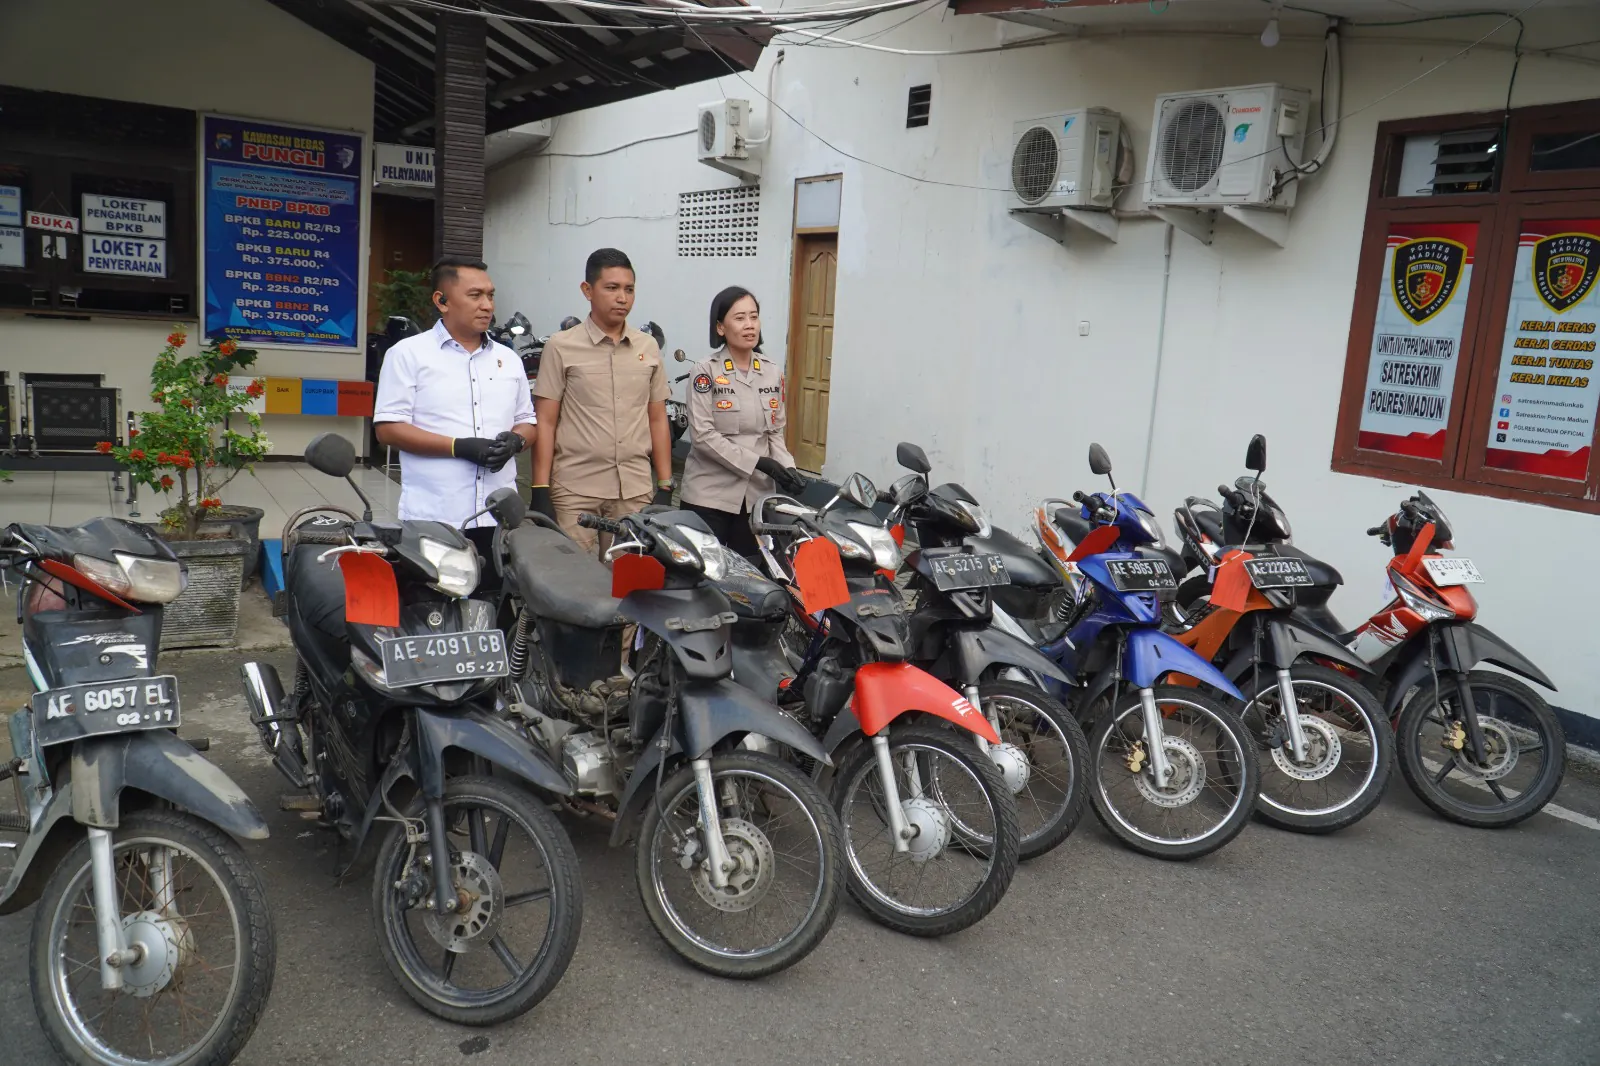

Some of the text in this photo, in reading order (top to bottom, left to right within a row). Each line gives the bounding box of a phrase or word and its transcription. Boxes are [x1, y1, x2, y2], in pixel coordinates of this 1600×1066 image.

[243, 130, 325, 150] KAWASAN BEBAS
[243, 143, 325, 168] PUNGLI
[382, 165, 433, 183] PELAYANAN
[102, 199, 147, 212] LOKET
[236, 195, 331, 216] PNBP BPKB
[31, 215, 74, 230] BUKA
[87, 208, 162, 224] PENGAMBILAN
[224, 214, 341, 234] BPKB BARU R2/R3
[106, 221, 144, 233] BPKB
[242, 227, 325, 243] Rp. 225.000,-
[92, 238, 158, 258] LOKET 2
[236, 243, 330, 259] BPKB BARU R4
[1410, 243, 1450, 253] POLRES
[1550, 245, 1591, 255] MADIUN
[1551, 238, 1591, 248] POLRES
[242, 254, 324, 270] Rp. 375.000,-
[1409, 251, 1450, 262] MADIUN
[88, 256, 162, 274] PENYERAHAN
[225, 270, 340, 287] BPKB BBN2 R2/R3
[242, 282, 324, 297] Rp. 225.000,-
[1566, 270, 1594, 304] KRIMINAL
[1426, 279, 1453, 314] KRIMINAL
[236, 298, 330, 313] BPKB BBN2 R4
[242, 310, 324, 324] Rp. 375.000,-
[225, 327, 340, 340] SATLANTAS POLRES MADIUN
[1520, 320, 1596, 333] KERJA KERAS
[1419, 337, 1434, 357] DAN
[1435, 339, 1454, 359] TPPO
[1514, 337, 1596, 352] KERJA CERDAS
[1511, 355, 1594, 370] KERJA TUNTAS
[1381, 361, 1442, 388] SATRESKRIM
[1510, 372, 1589, 388] KERJA IKHLAS
[713, 387, 736, 395] ANITA
[1369, 390, 1445, 419] POLRES MADIUN
[1516, 411, 1589, 424] Satreskrim Polres Madiun
[1513, 424, 1536, 432] POLRES
[1560, 429, 1585, 437] OFFICIAL
[1512, 437, 1569, 448] satreskrimmadiun
[1186, 533, 1210, 567] HOND
[935, 560, 950, 574] AE
[954, 557, 983, 572] 5215
[1112, 561, 1127, 575] AE
[1127, 561, 1153, 575] 5965
[394, 635, 501, 662] AE 4091 GB
[47, 684, 172, 719] AE 6057 EL
